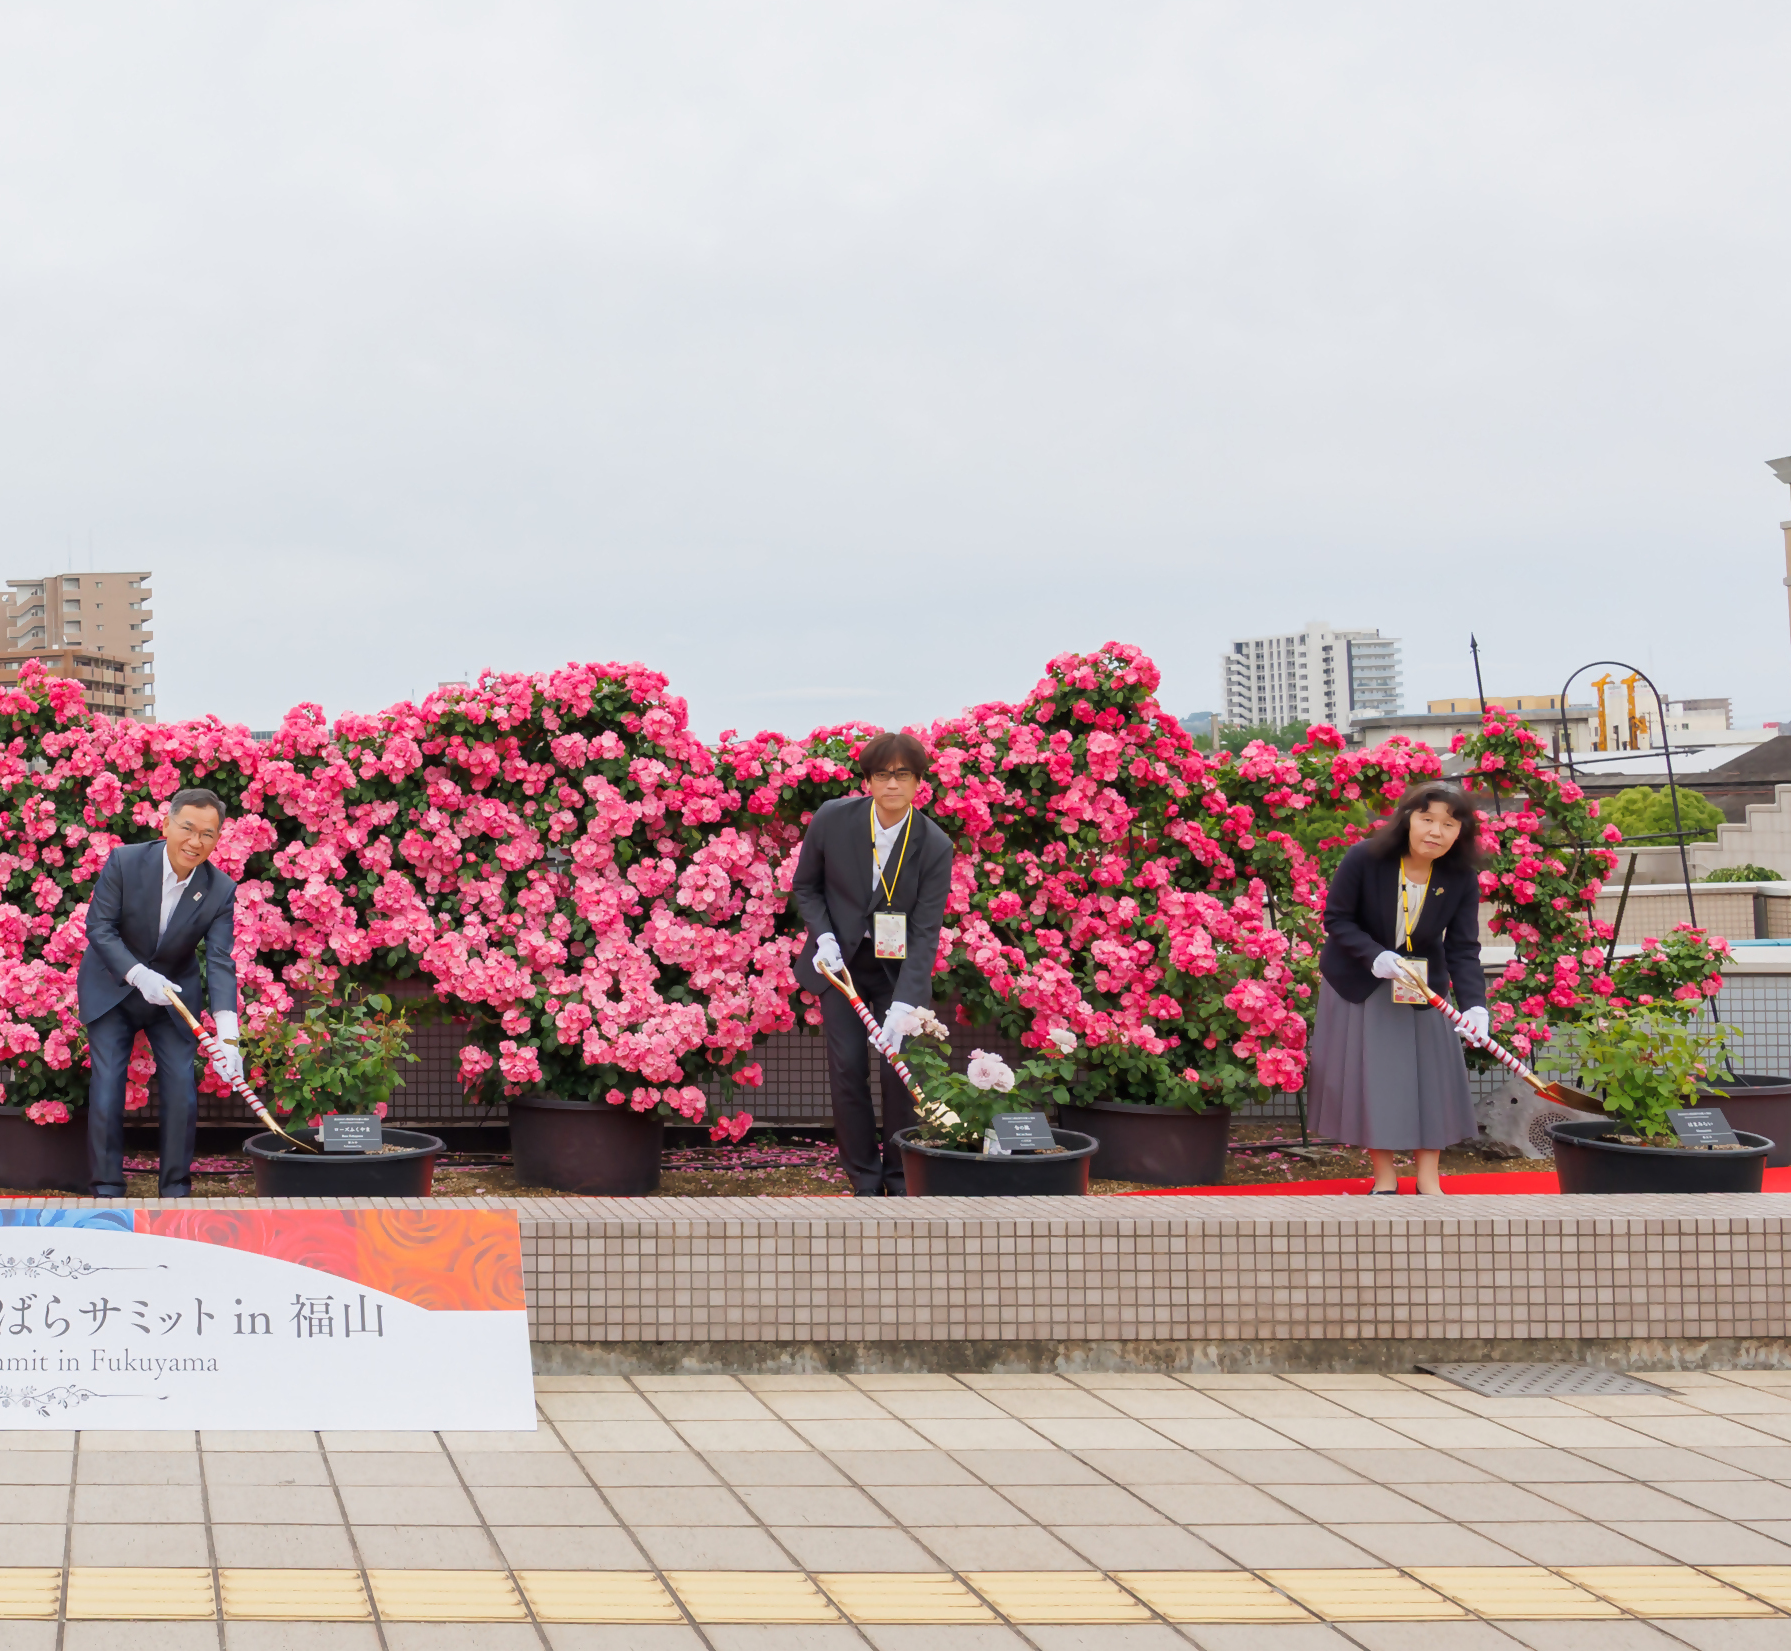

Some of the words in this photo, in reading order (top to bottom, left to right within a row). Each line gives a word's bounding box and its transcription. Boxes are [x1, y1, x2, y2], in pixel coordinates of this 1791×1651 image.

[233, 1298, 274, 1335] in
[289, 1293, 385, 1339] 福山
[58, 1348, 80, 1371] in
[92, 1347, 219, 1381] Fukuyama
